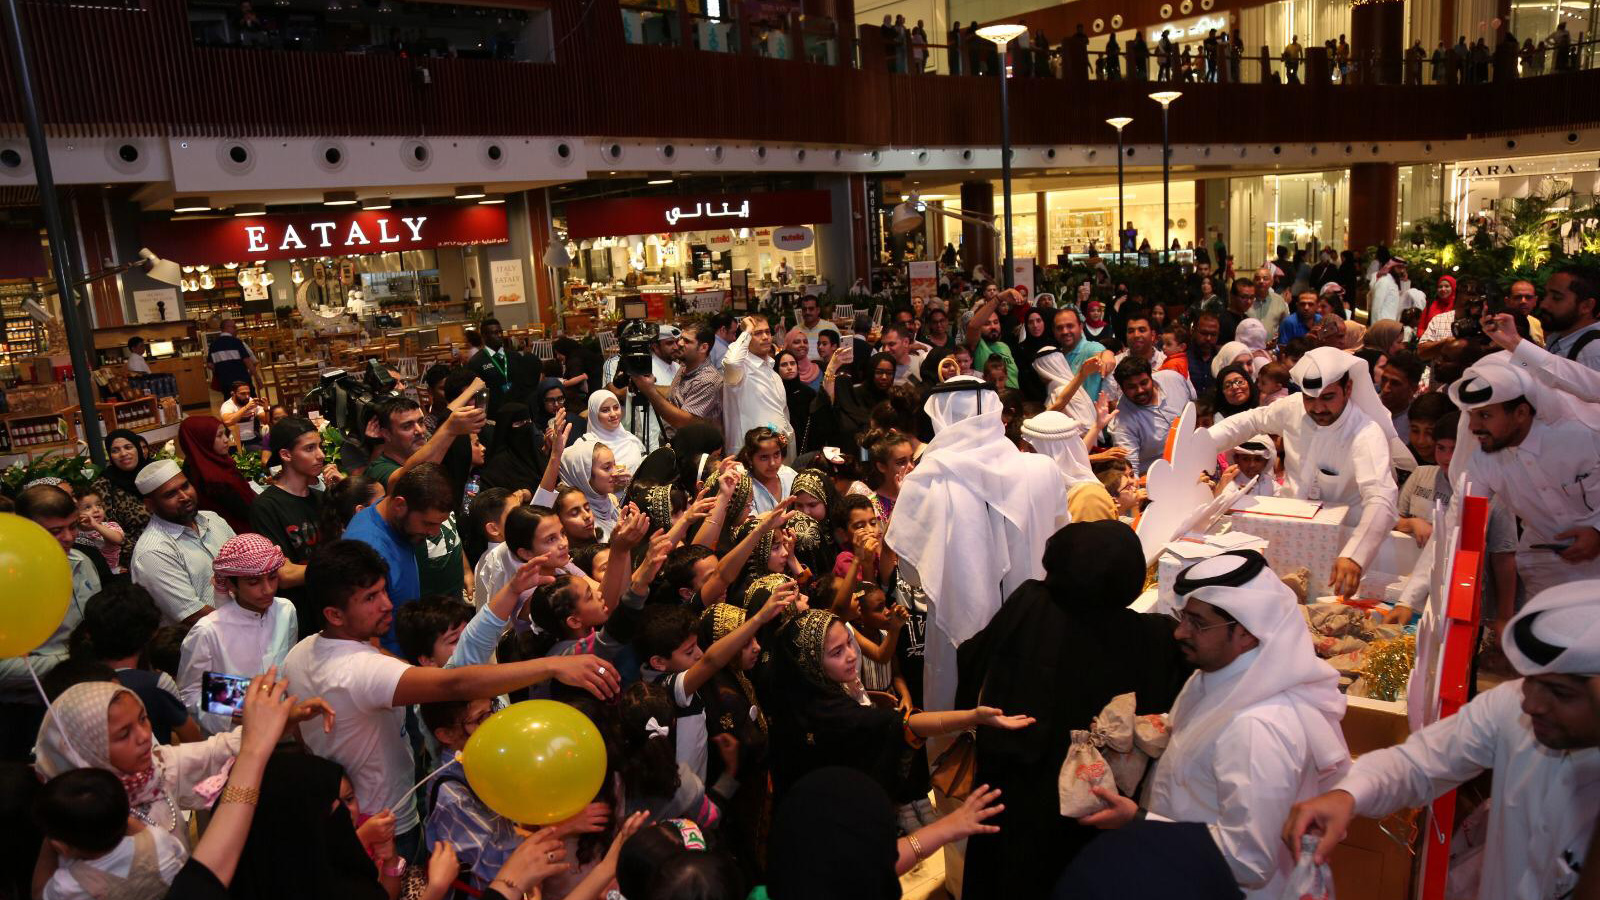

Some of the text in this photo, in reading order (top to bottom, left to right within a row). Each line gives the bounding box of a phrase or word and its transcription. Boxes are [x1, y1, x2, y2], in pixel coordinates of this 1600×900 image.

[1458, 164, 1516, 177] ZARA
[245, 217, 427, 252] EATALY
[495, 276, 520, 284] EATALY
